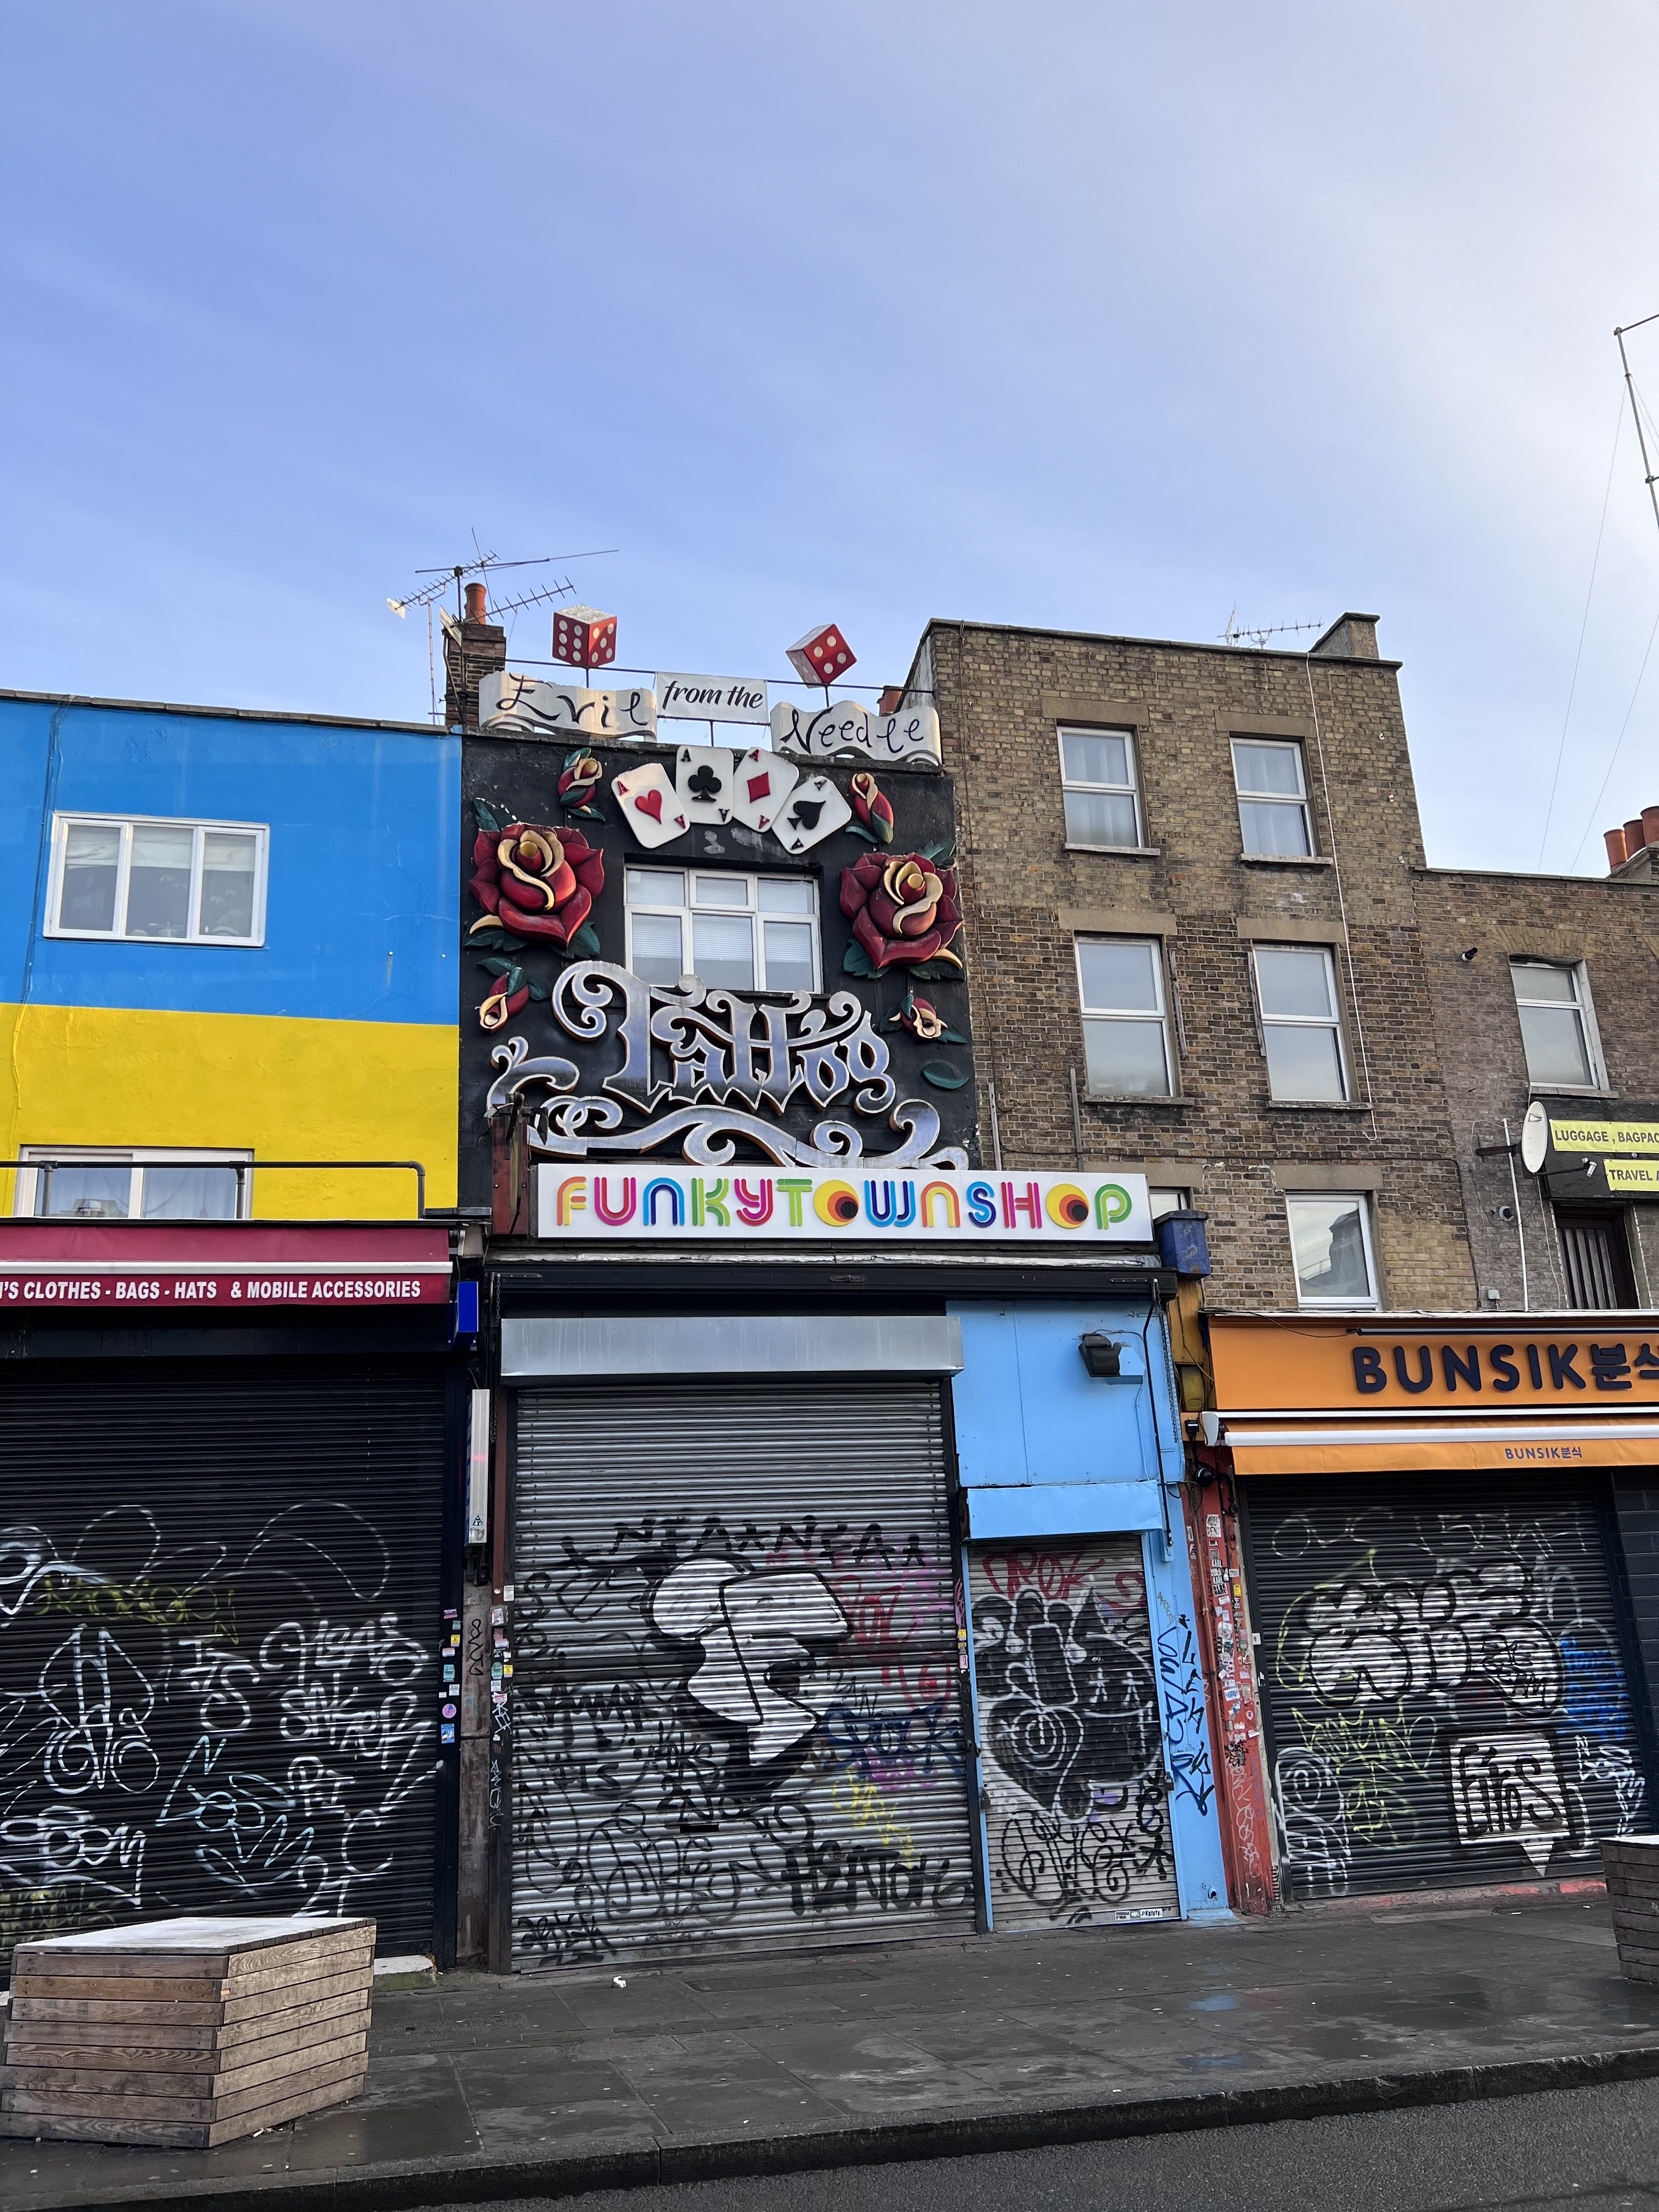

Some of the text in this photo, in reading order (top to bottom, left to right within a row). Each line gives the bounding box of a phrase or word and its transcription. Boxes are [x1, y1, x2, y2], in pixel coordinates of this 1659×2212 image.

[496, 674, 650, 729] Evil
[663, 680, 764, 710] from the
[780, 702, 924, 753] Needle
[1554, 1130, 1609, 1142] LUGGAGE
[1609, 1169, 1653, 1181] TRAVEL
[24, 1280, 101, 1300] CLOTHES
[115, 1281, 160, 1300] BAGS
[174, 1281, 217, 1299] HATS
[230, 1281, 242, 1299] &
[247, 1281, 308, 1299] MOBILE
[312, 1280, 421, 1298] ACCESSORIES
